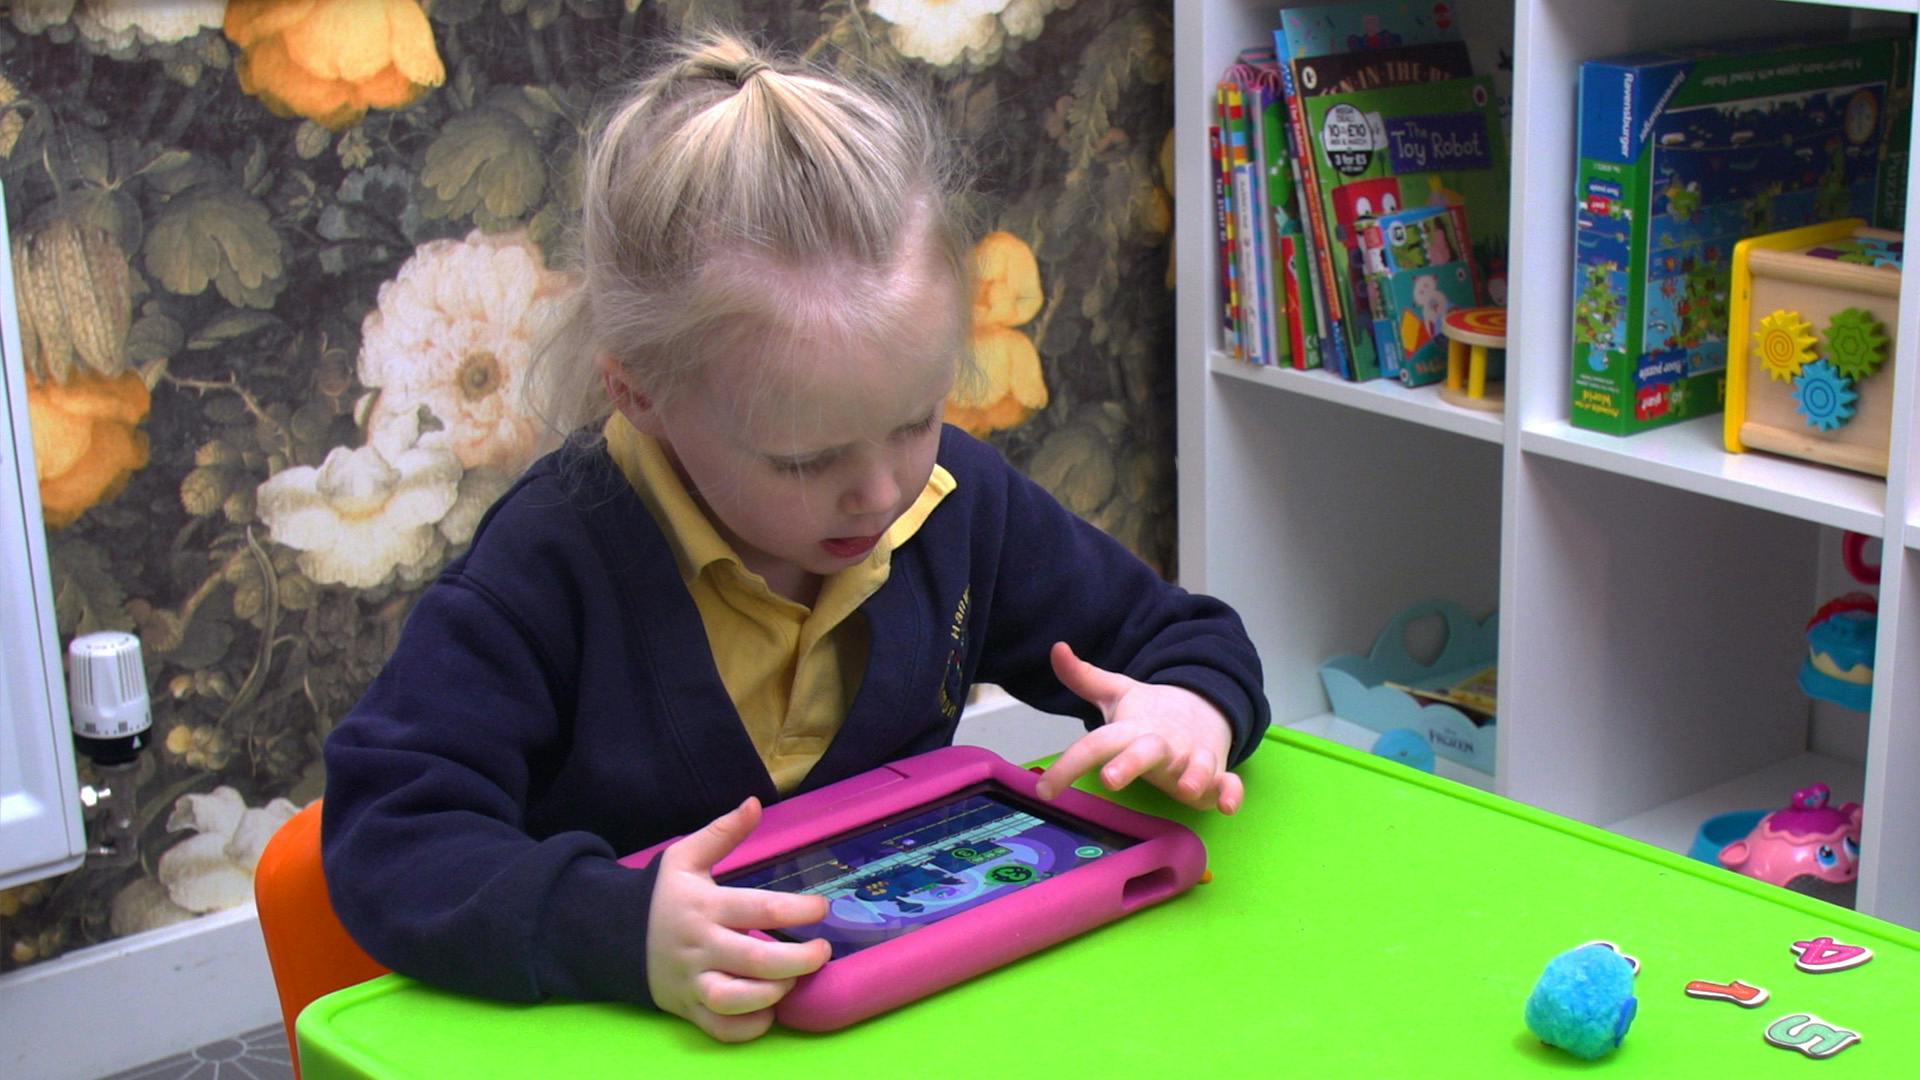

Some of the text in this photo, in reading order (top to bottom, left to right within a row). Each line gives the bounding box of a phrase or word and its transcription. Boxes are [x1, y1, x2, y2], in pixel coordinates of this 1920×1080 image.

[1385, 61, 1422, 82] THE
[1621, 72, 1634, 159] Ravensburger
[1328, 123, 1340, 137] 10
[1347, 123, 1366, 137] £10
[1404, 120, 1428, 139] The
[1390, 128, 1484, 167] Toy Robot
[1334, 153, 1342, 166] 3
[1766, 1014, 1860, 1057] 5
